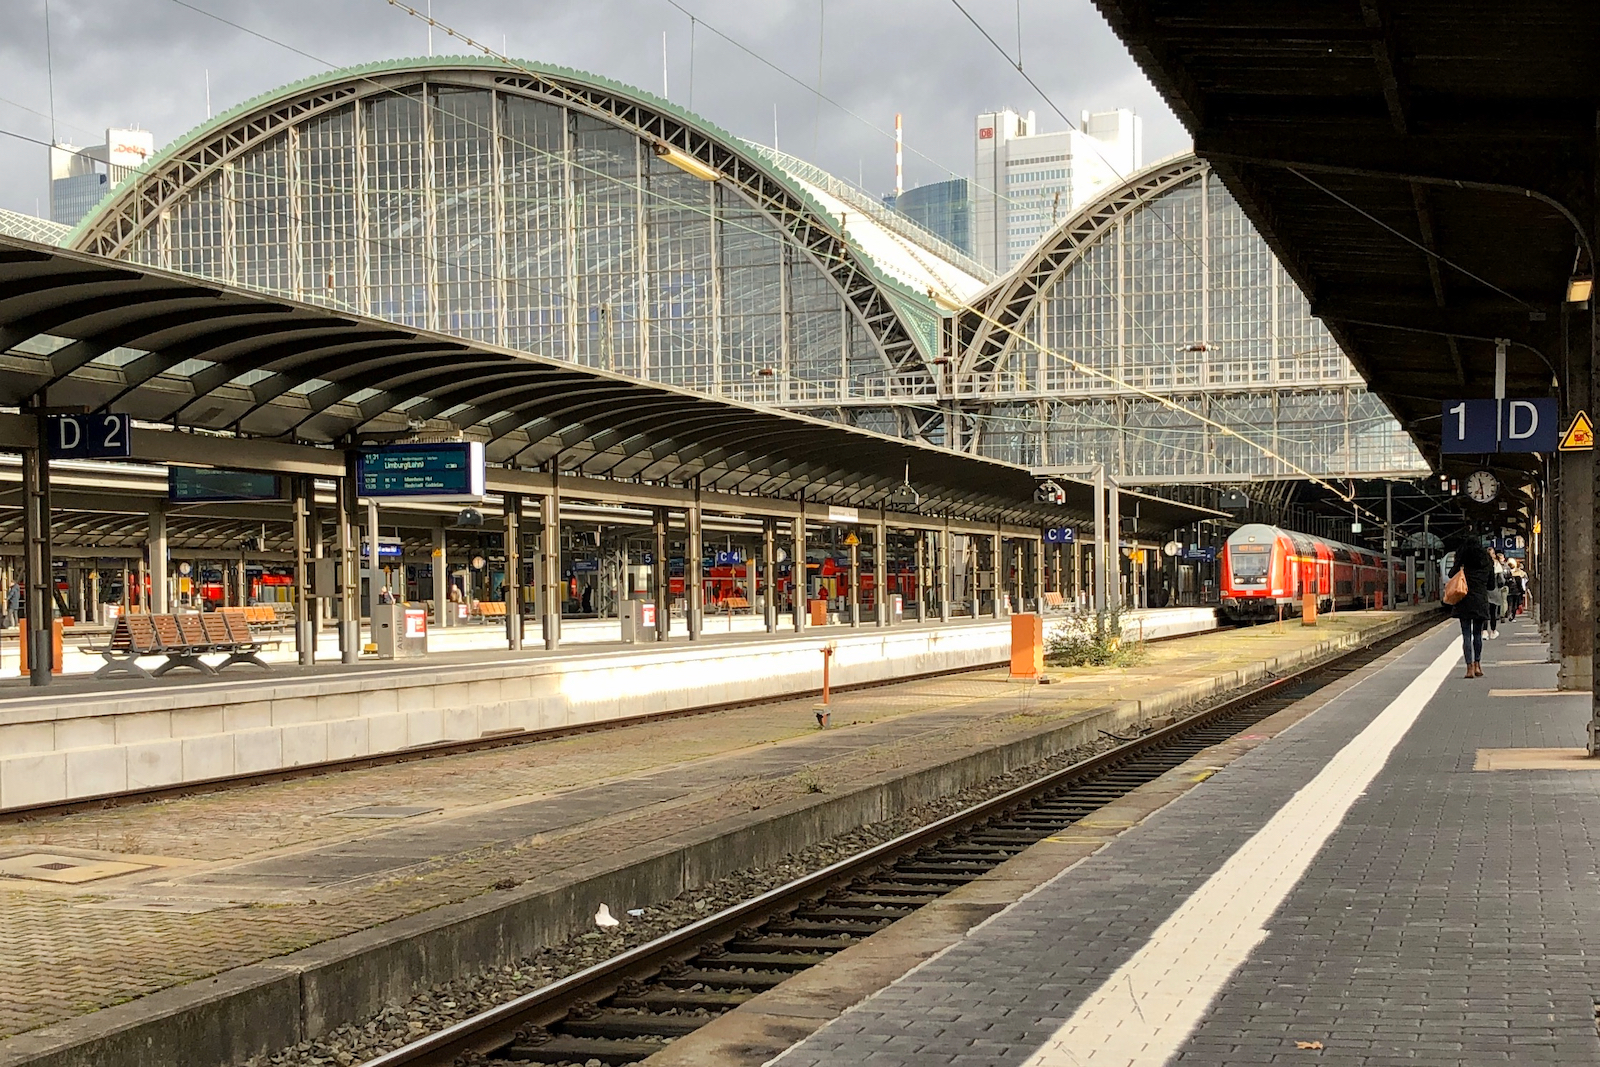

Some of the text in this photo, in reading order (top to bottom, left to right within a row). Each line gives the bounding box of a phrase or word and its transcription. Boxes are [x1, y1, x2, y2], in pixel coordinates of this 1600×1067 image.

[981, 129, 993, 138] DB
[1450, 401, 1538, 440] 1 D
[60, 415, 121, 449] D 2
[1048, 528, 1072, 540] C 2
[1491, 538, 1513, 548] 1 C
[644, 554, 651, 563] 5
[720, 552, 739, 561] C 4
